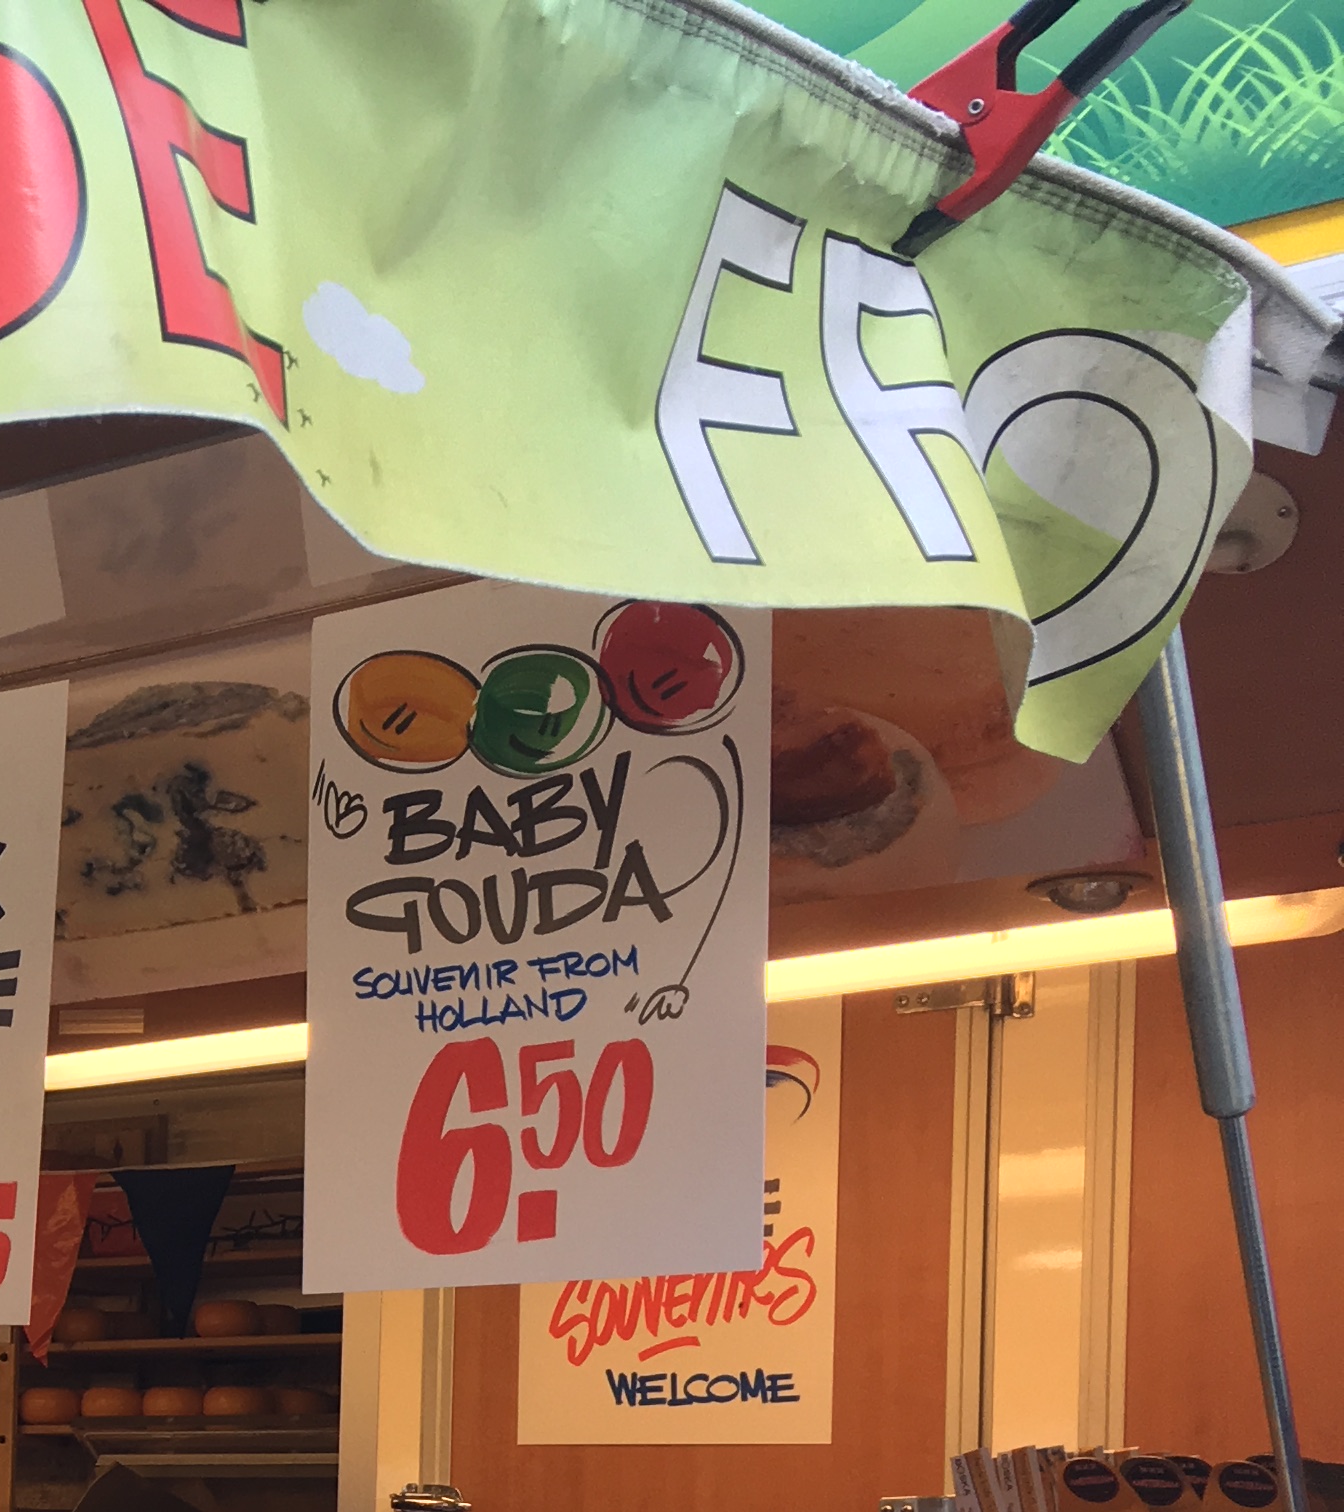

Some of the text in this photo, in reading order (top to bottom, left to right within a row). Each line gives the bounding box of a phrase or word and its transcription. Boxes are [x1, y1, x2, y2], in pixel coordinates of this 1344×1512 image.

[382, 750, 632, 869] BABY
[346, 838, 688, 955] GOUDA
[352, 946, 639, 1002] SOUVENIR FROM
[414, 988, 587, 1033] HOLLAND
[605, 1367, 801, 1408] WELCOME
